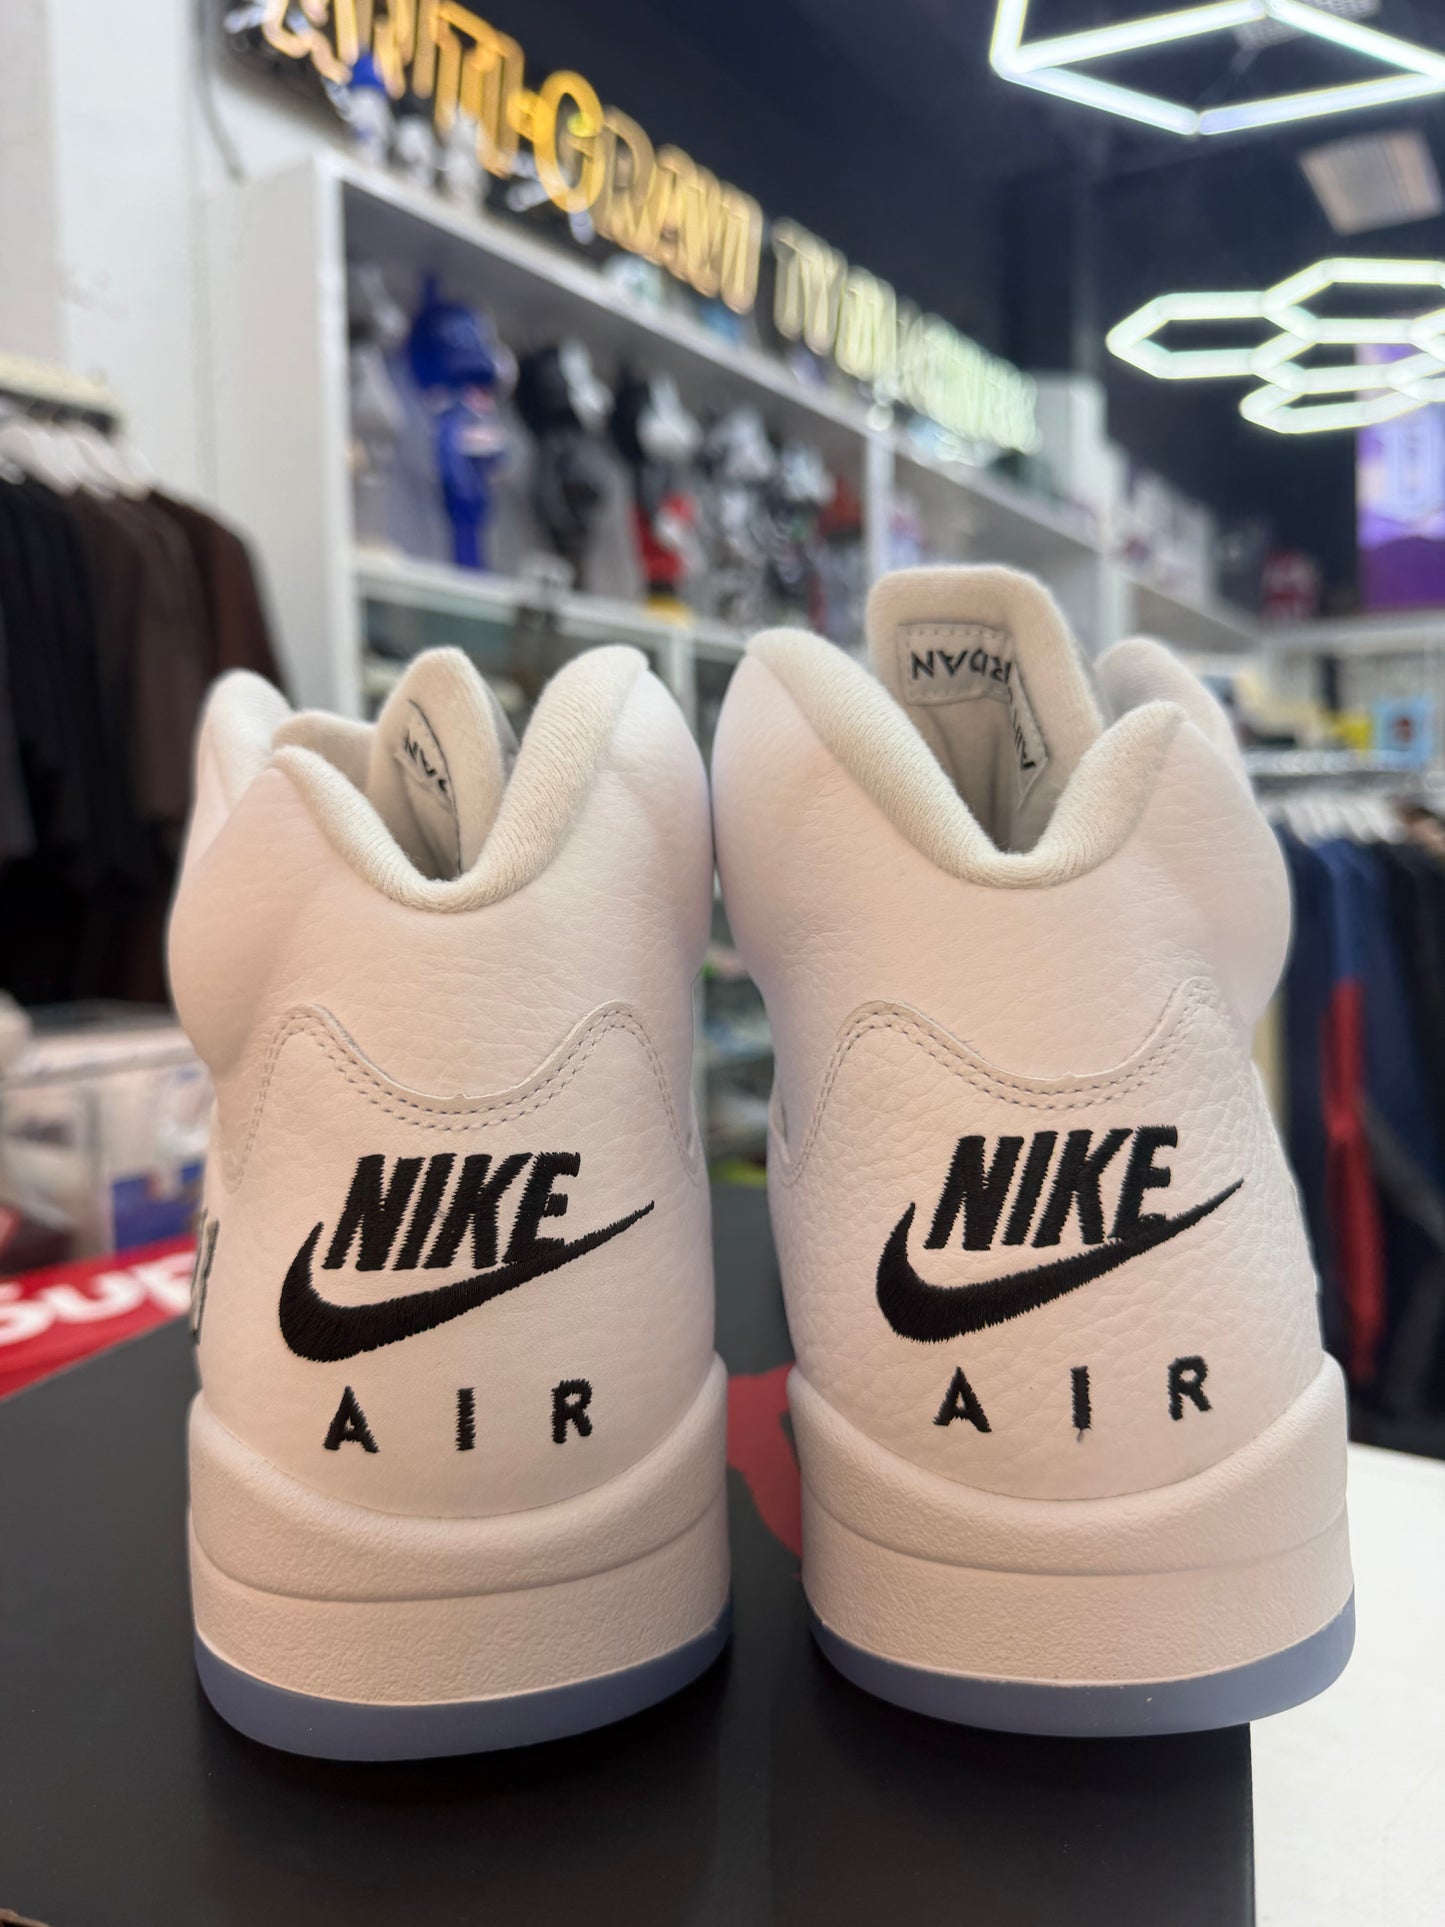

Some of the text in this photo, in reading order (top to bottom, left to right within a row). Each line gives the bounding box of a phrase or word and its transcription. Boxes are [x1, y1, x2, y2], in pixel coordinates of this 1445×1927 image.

[321, 1152, 581, 1271] NIKE
[923, 1125, 1178, 1250] NIKE
[323, 1379, 593, 1453] AIR
[932, 1355, 1212, 1432] AIR
